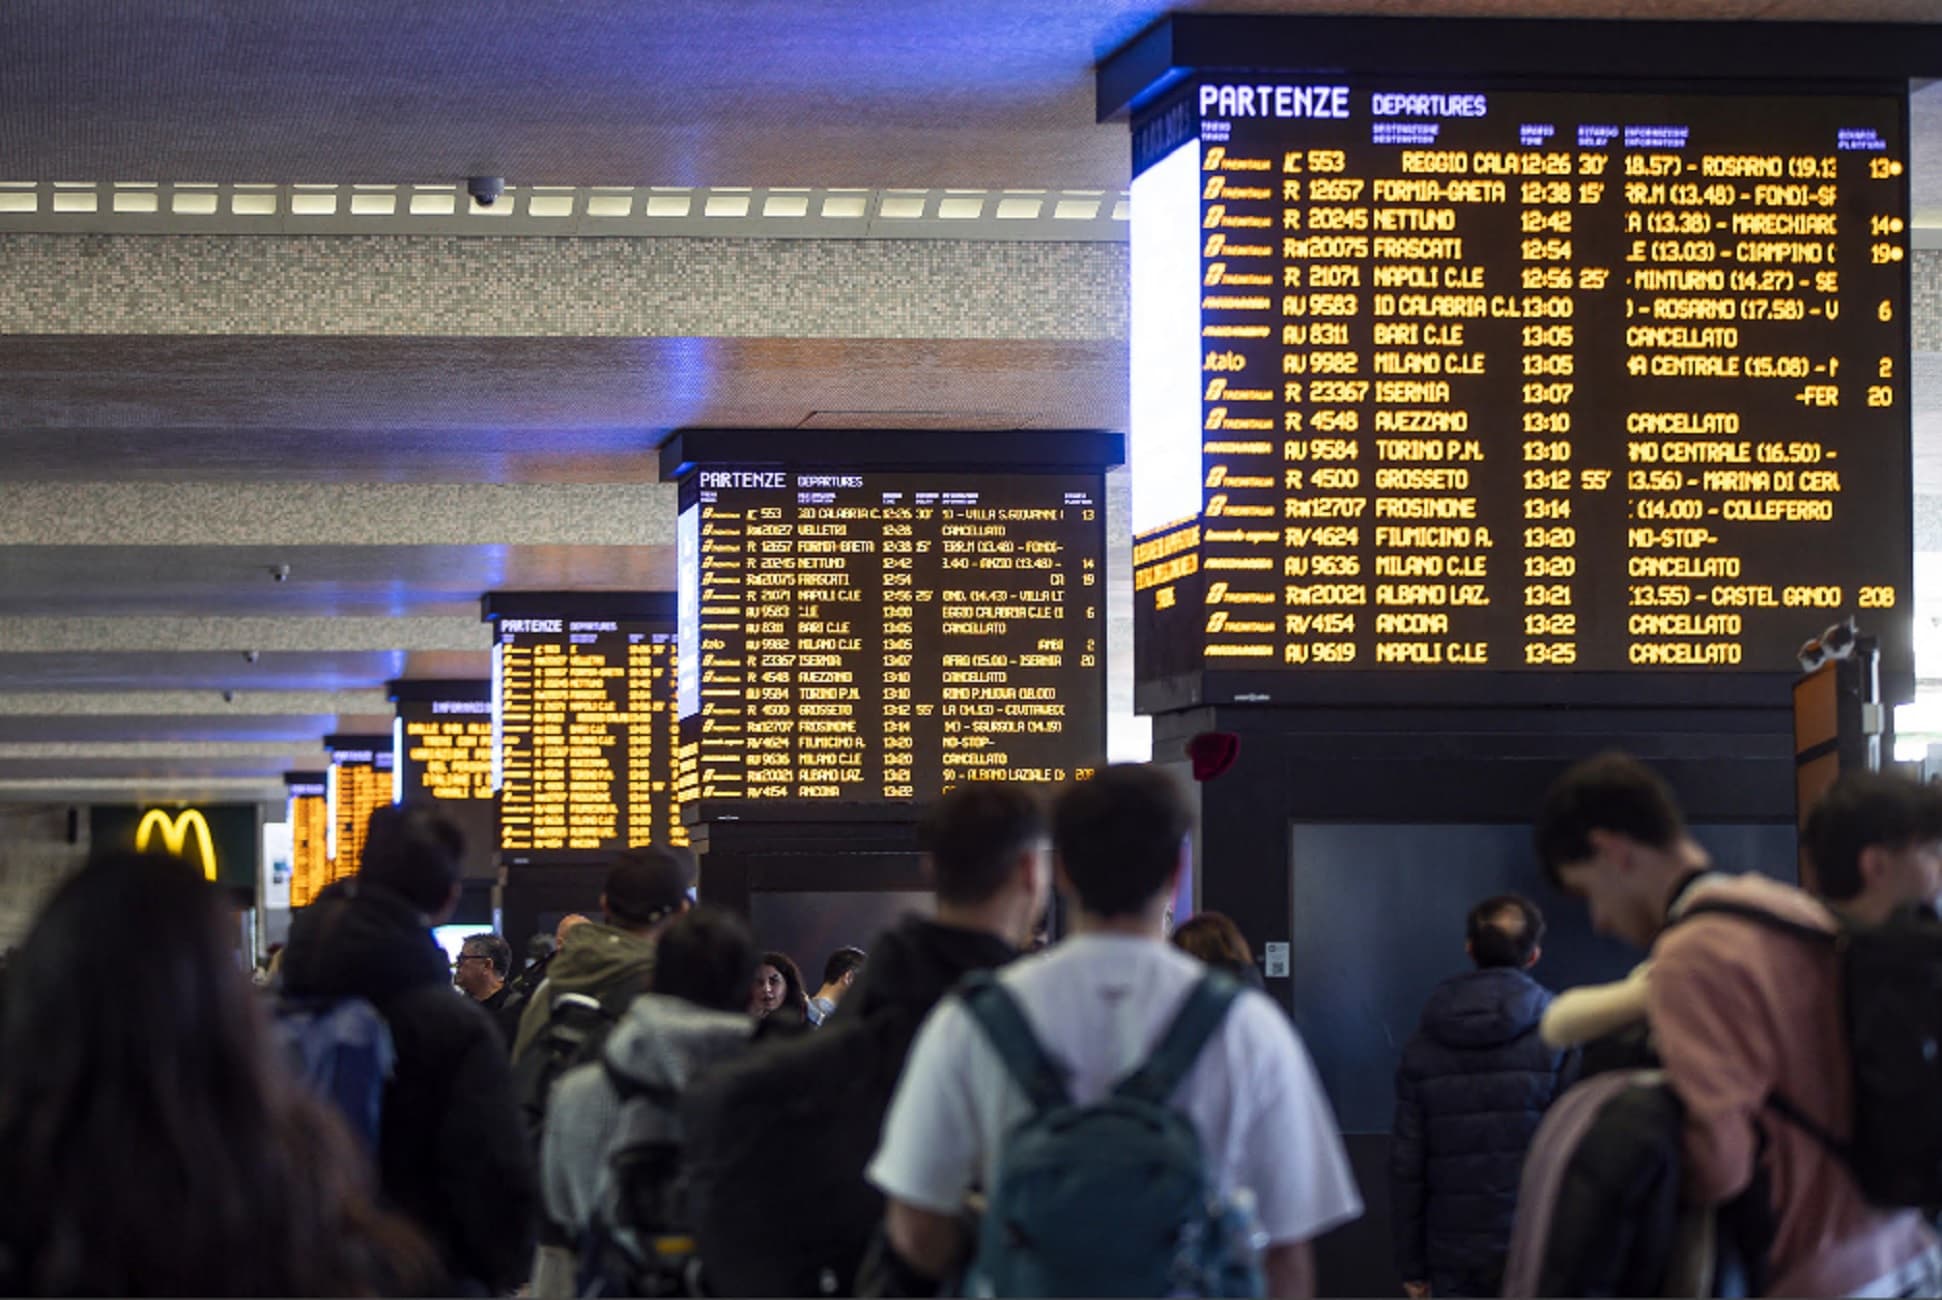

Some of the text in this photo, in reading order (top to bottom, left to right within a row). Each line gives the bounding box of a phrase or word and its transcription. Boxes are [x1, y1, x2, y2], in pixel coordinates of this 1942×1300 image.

[1200, 86, 1486, 118] PARTENZE DEPARTURES
[1308, 150, 1345, 172] 553
[1403, 151, 1467, 173] REGGIO
[1474, 152, 1521, 174] CALA
[1519, 153, 1571, 174] 12:26
[1625, 155, 1681, 176] 18.57)
[1703, 156, 1782, 177] ROSARNO
[1870, 158, 1892, 178] 13
[1283, 180, 1300, 200] R
[1309, 179, 1364, 201] 12657
[1374, 180, 1505, 202] FORMIA-GAETA
[1521, 182, 1571, 203] 12:38
[1670, 184, 1735, 205] (13.48)
[1283, 209, 1300, 229] R
[1309, 207, 1368, 230] 20245
[1374, 209, 1455, 230] NETTUNO
[1521, 210, 1571, 232] 12:42
[1648, 211, 1710, 233] (13.38)
[1872, 216, 1892, 235] 14
[1374, 237, 1892, 263] FRASCATI 12:54 (13.03) CIAMPINO 19
[1284, 267, 1300, 287] R
[1310, 265, 1360, 286] 21071
[1374, 266, 1438, 287] NAPOLI
[1445, 267, 1484, 288] C.LE
[1522, 267, 1573, 288] 12:56
[1635, 269, 1724, 290] MINTURNO
[1731, 270, 1793, 290] (14.27)
[1816, 271, 1838, 292] SE
[1310, 294, 1358, 315] 9583
[1399, 295, 1487, 317] CALABRIA
[1520, 296, 1573, 317] 13:00
[1654, 298, 1735, 319] ROSARNO
[1741, 299, 1804, 319] (17.58)
[1879, 301, 1891, 321] 6
[1310, 323, 1348, 344] 8311
[1374, 323, 1418, 344] BARI
[1424, 324, 1463, 345] C.LE
[1523, 326, 1573, 346] 13:05
[1627, 326, 1737, 348] CANCELLATO
[1310, 352, 1358, 373] 9982
[1374, 352, 1440, 373] MILANO
[1445, 353, 1484, 373] C.LE
[1523, 355, 1573, 375] 13:05
[1652, 355, 1739, 376] CENTRALE
[1745, 357, 1809, 377] (15.08)
[1880, 357, 1892, 377] 2
[1285, 382, 1302, 402] R
[1310, 381, 1369, 402] 23367
[1376, 381, 1449, 402] ISERNIA
[1523, 383, 1573, 403] 13:07
[1868, 386, 1892, 406] 20
[1285, 412, 1302, 431] R
[1310, 411, 1358, 431] 4548
[1376, 411, 1467, 431] AVEZZANO
[1523, 412, 1570, 432] 13:10
[1627, 413, 1739, 433] CANCELLATO
[1310, 439, 1358, 460] 9584
[1376, 440, 1443, 460] TORINO
[1523, 441, 1570, 461] 13:10
[1662, 442, 1751, 462] CENTRALE
[1757, 443, 1820, 462] (16.50)
[700, 473, 863, 488] PARTENZE DEPARTURES
[1285, 470, 1302, 489] R
[1310, 468, 1359, 488] 4500
[1376, 469, 1468, 489] GROSSETO
[1524, 469, 1571, 489] 13:12
[1704, 471, 1770, 491] MARINA
[1774, 471, 1794, 491] DI
[1376, 498, 1832, 520] FROSINONE 13:14 (14.00) COLLEFERRO
[1309, 527, 1359, 546] 4624
[1376, 527, 1470, 547] FIUMICINO
[1524, 527, 1575, 547] 13:20
[1311, 555, 1360, 575] 9636
[1376, 556, 1443, 576] MILANO
[1447, 556, 1486, 576] C.LE
[1525, 556, 1575, 576] 13:20
[1629, 557, 1740, 577] CANCELLATO
[1376, 585, 1446, 605] ALBANO
[1525, 585, 1571, 605] 13:21
[1712, 586, 1779, 606] CASTEL
[1783, 587, 1841, 607] GANDO
[1859, 587, 1895, 607] 208
[1310, 614, 1355, 632] 4154
[1376, 614, 1448, 633] ANCONA
[1525, 614, 1575, 634] 13:22
[1629, 614, 1741, 634] CANCELLATO
[1312, 643, 1355, 661] 9619
[1376, 643, 1442, 662] NAPOLI
[1447, 643, 1487, 663] C.LE
[1525, 643, 1576, 663] 13:25
[1629, 643, 1741, 663] CANCELLATO
